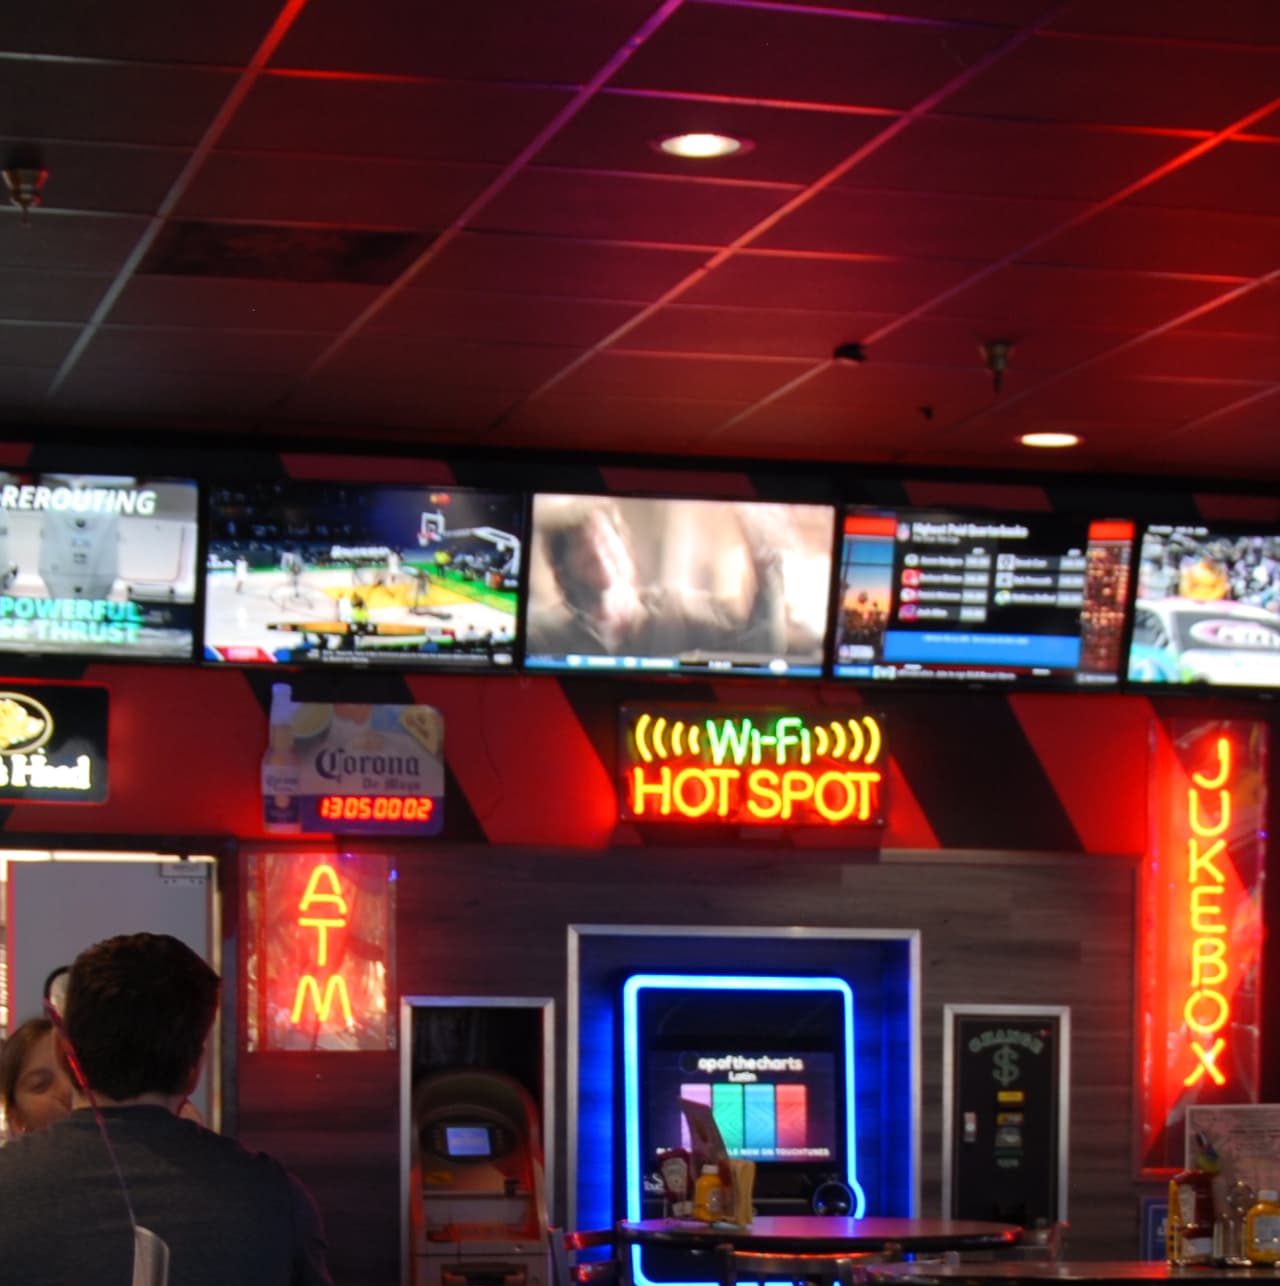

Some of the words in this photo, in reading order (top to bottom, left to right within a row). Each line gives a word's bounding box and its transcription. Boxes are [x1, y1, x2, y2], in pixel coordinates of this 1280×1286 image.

[1, 485, 157, 514] REROUTING
[34, 618, 142, 643] THRUST
[706, 717, 811, 765] Wi-Fi
[315, 747, 421, 784] Corona
[633, 766, 740, 817] HOT
[747, 769, 881, 821] SPOT
[1183, 738, 1232, 1087] JUKEBOX
[291, 865, 355, 1028] ATM
